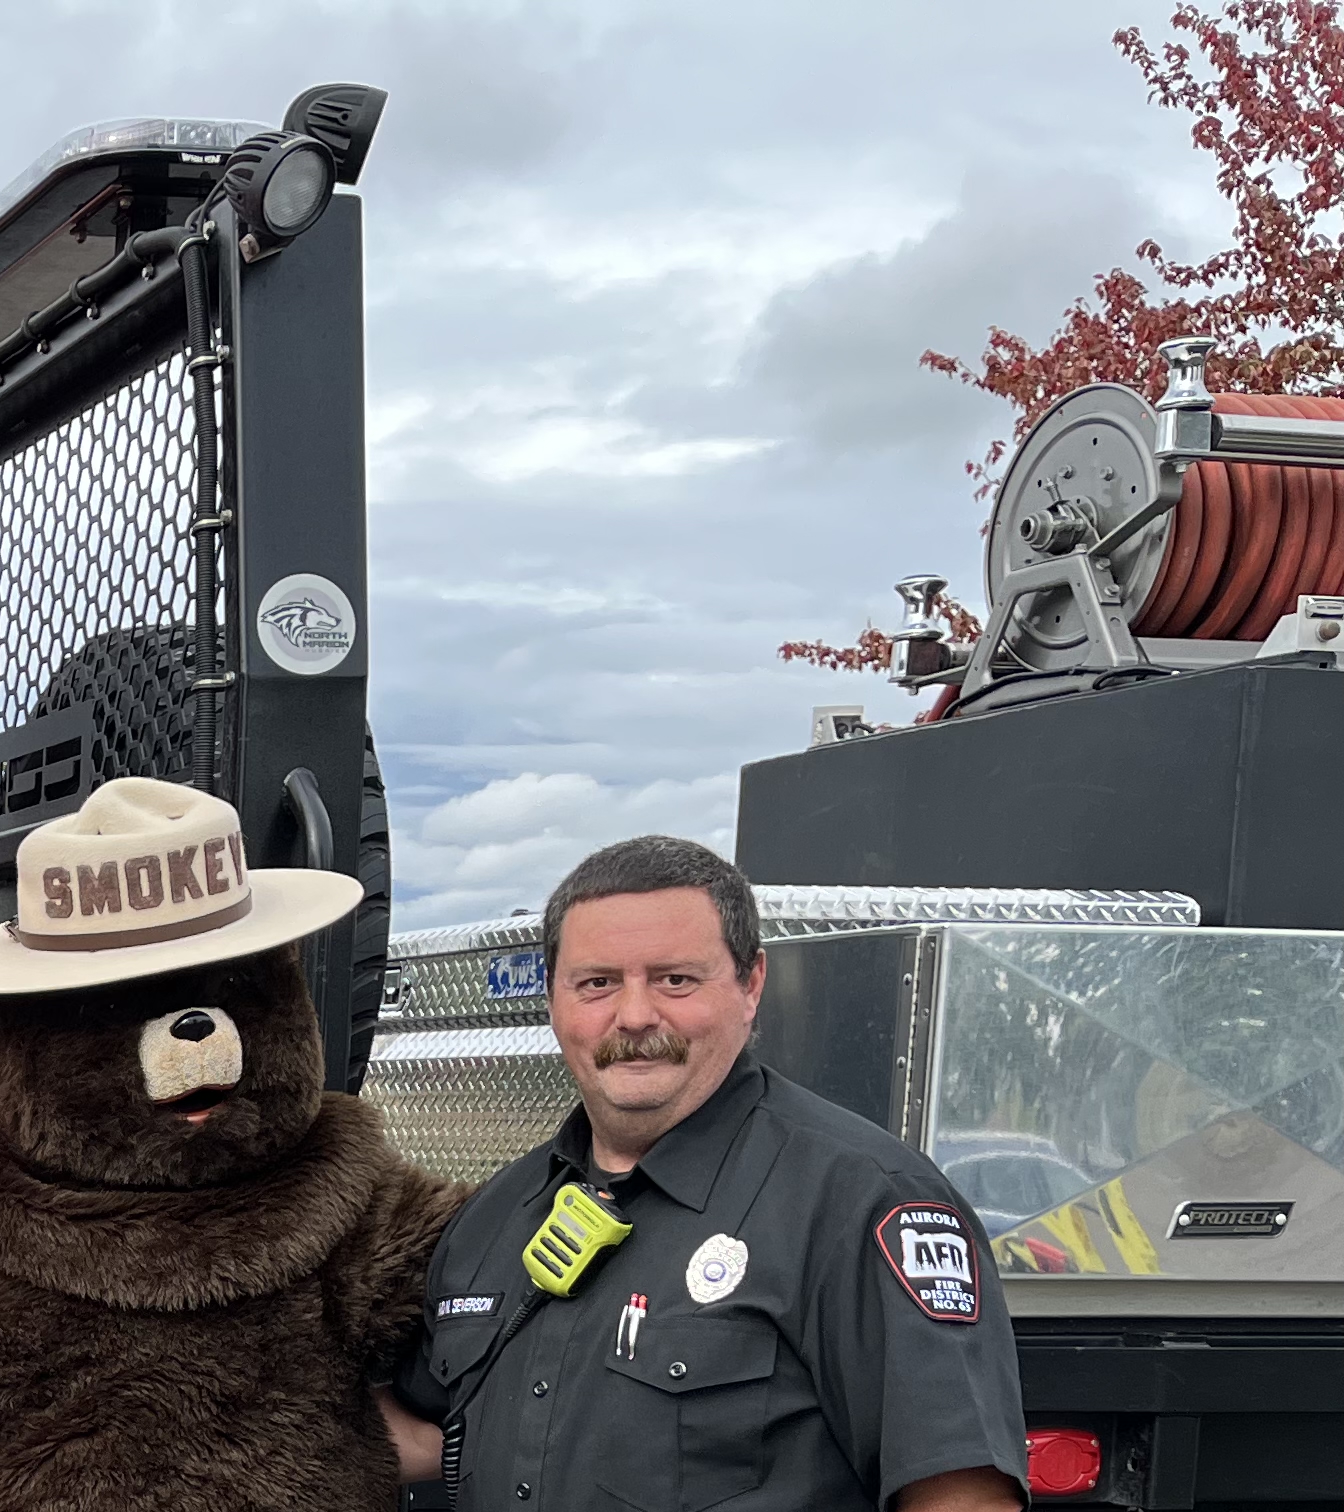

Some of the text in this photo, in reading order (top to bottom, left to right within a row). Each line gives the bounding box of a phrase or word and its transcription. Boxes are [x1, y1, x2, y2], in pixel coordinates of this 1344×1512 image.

[42, 831, 246, 919] SMOKEY
[900, 1212, 960, 1228] AURORA
[935, 1280, 962, 1291] FIRE
[920, 1290, 975, 1304] DISTRICT
[934, 1300, 971, 1312] NO. 63
